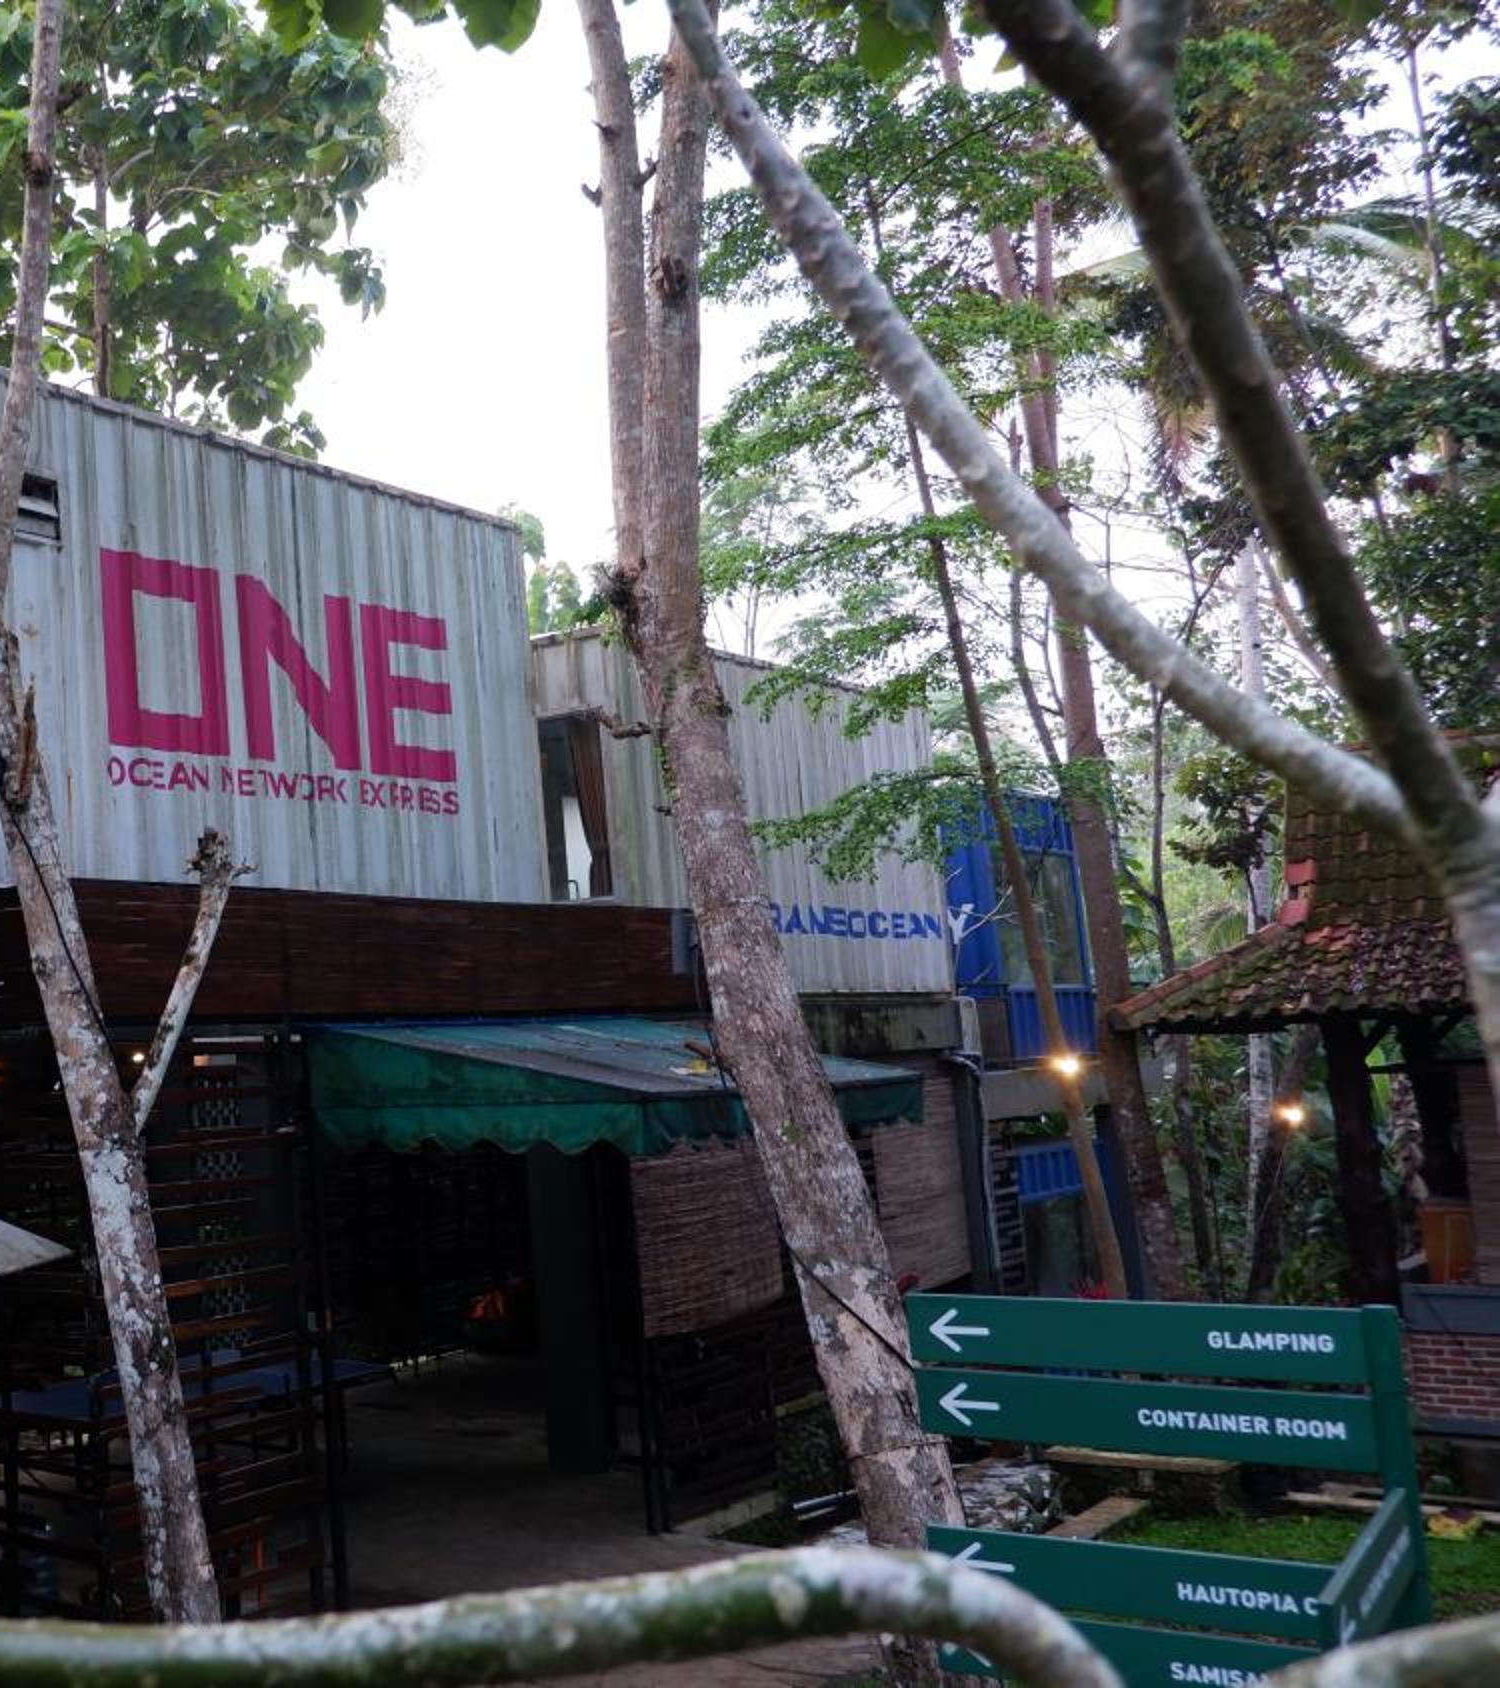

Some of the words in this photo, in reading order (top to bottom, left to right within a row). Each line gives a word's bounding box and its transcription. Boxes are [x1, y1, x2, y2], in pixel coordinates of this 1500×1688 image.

[100, 549, 457, 782] ONE
[108, 757, 209, 790] OCEAN
[221, 766, 347, 804] NETWORK
[359, 779, 460, 815] EXPRESS
[1207, 1331, 1335, 1353] GLAMPING
[1137, 1408, 1270, 1435] CONTAINER
[1274, 1418, 1347, 1440] ROOM
[1176, 1581, 1299, 1615] HAUTOPIA
